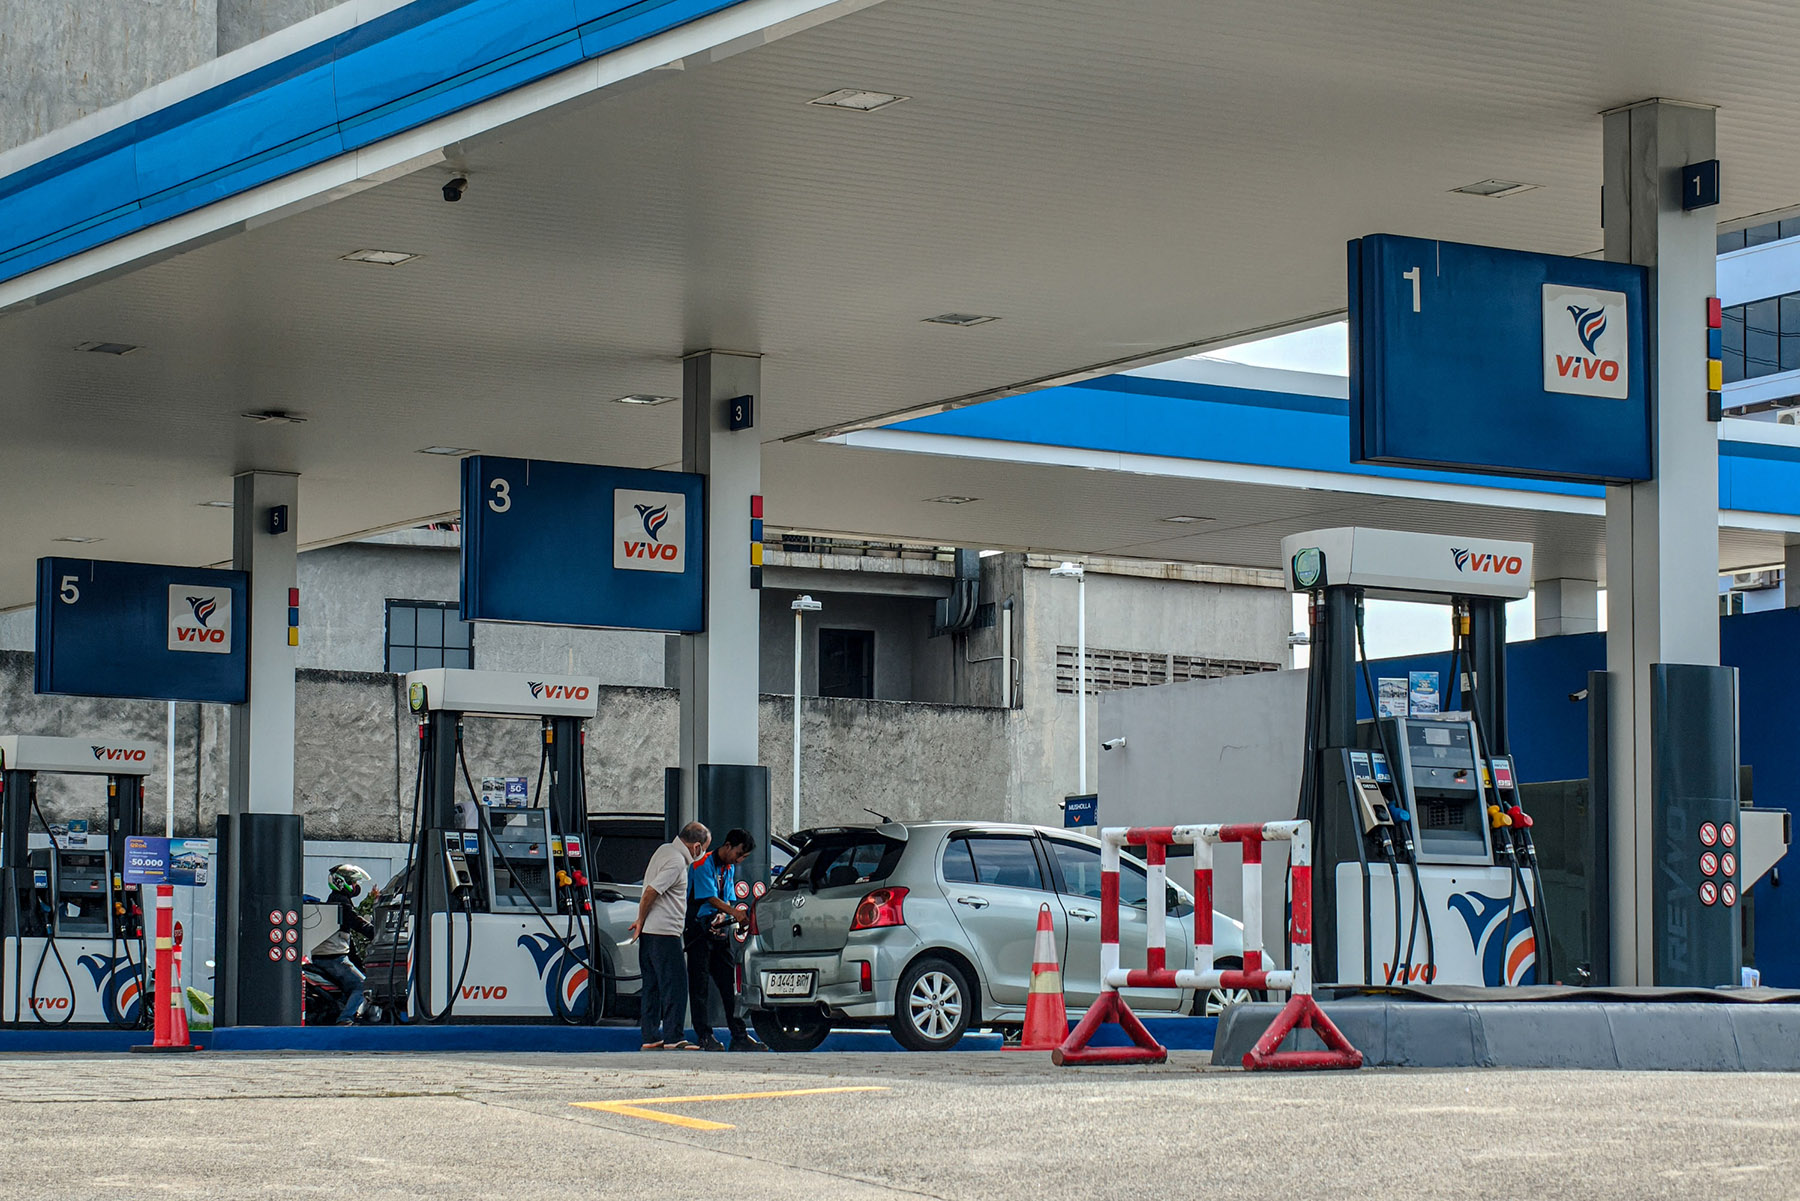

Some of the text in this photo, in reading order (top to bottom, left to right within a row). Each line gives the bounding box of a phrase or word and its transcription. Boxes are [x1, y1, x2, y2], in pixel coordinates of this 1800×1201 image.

[1692, 175, 1701, 196] 1
[1403, 266, 1421, 313] 1
[735, 405, 743, 421] 3
[488, 478, 512, 513] 3
[273, 512, 279, 526] 5
[59, 575, 80, 604] 5
[1068, 802, 1092, 811] MUSHOLLA
[131, 858, 164, 867] 50.000
[770, 975, 776, 987] B
[777, 975, 795, 987] 1441
